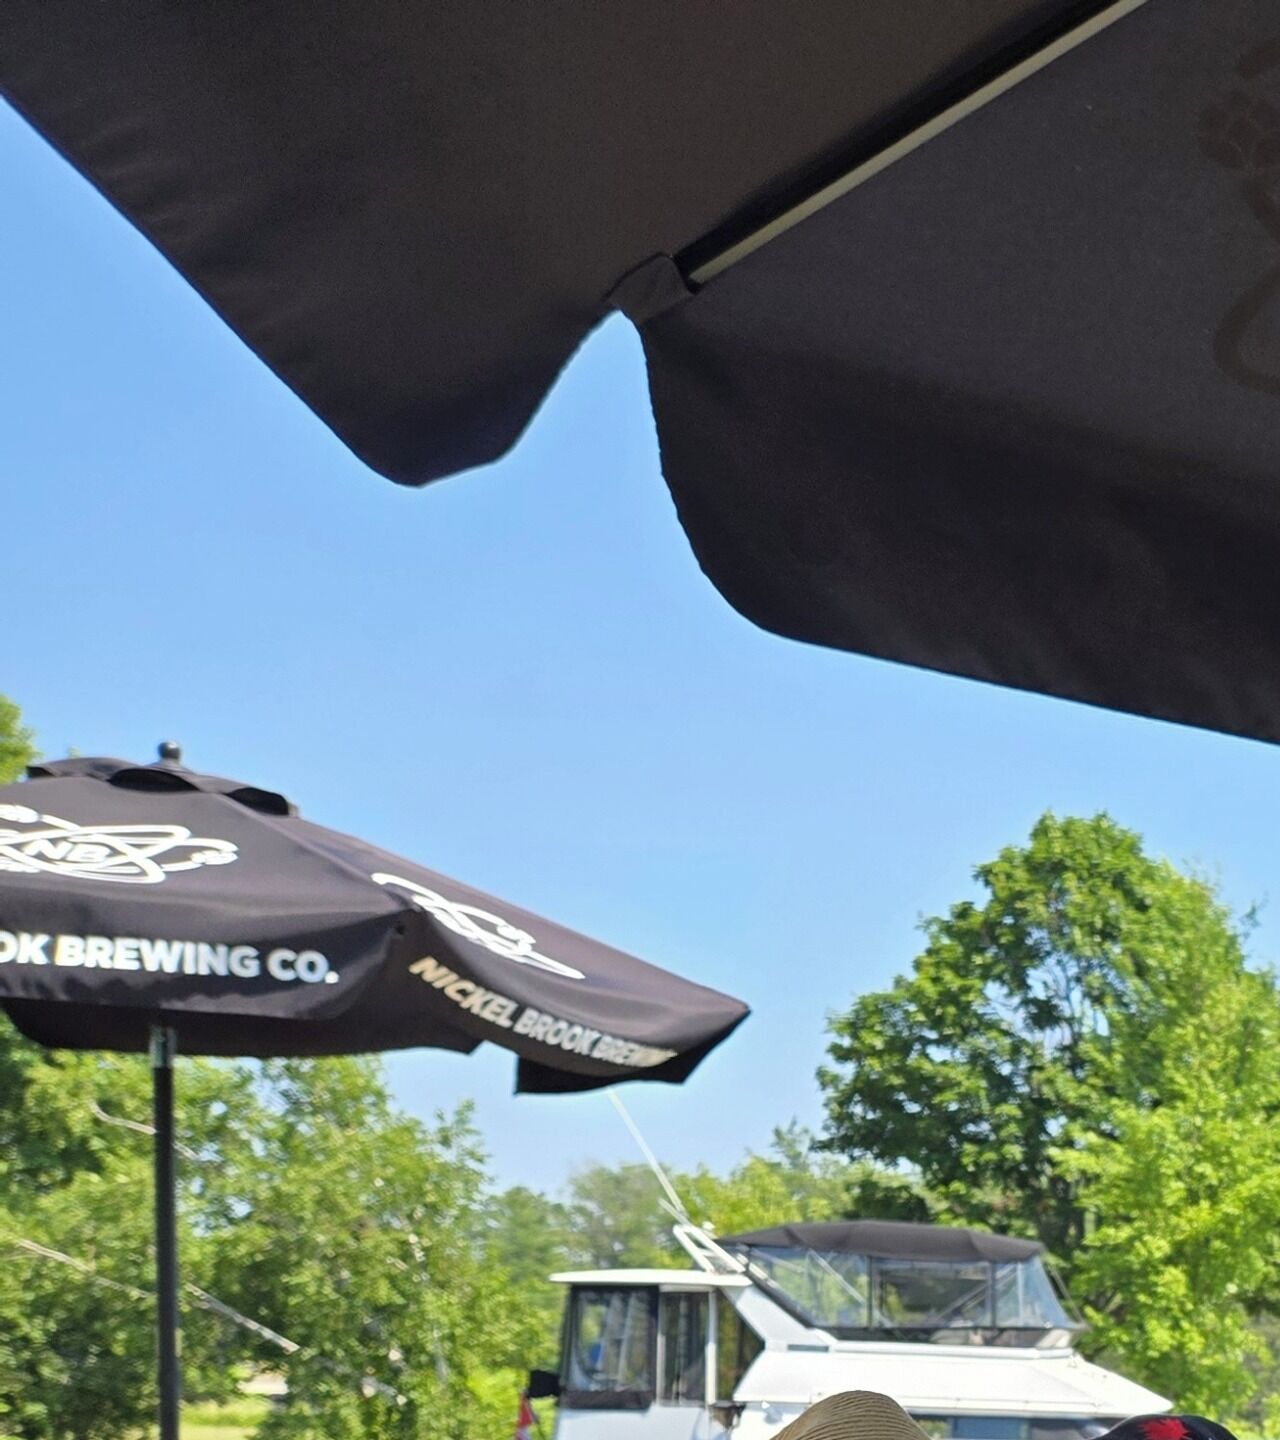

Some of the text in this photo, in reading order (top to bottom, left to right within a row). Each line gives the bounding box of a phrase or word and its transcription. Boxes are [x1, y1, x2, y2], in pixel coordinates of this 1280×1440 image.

[54, 934, 260, 979] BREWING
[267, 948, 340, 984] CO.
[408, 955, 519, 1029] NICKEL
[513, 1008, 602, 1056] BROOK
